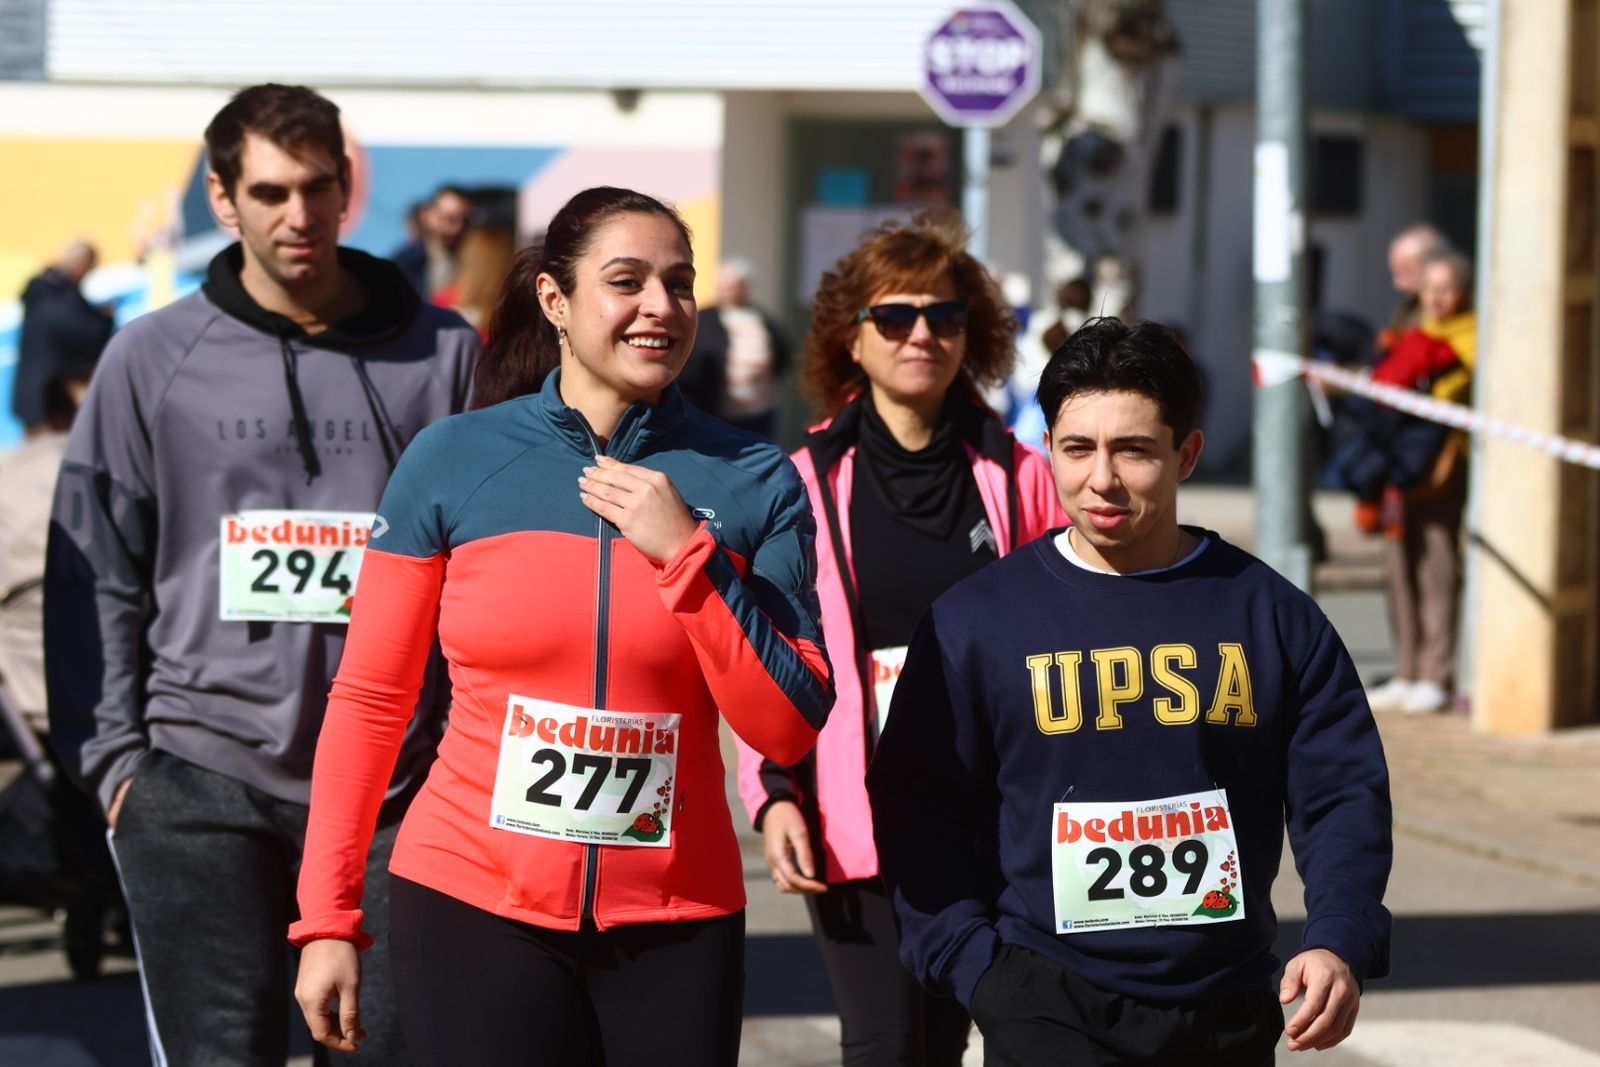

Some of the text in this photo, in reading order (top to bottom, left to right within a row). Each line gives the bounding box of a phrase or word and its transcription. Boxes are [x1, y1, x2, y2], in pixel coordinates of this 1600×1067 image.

[929, 37, 1029, 75] STOP
[217, 418, 404, 442] LOS AGEL
[227, 519, 371, 547] bedunia
[251, 549, 352, 595] 294
[1026, 643, 1258, 735] UPSA
[508, 704, 675, 755] bedunia
[525, 748, 652, 814] 277
[1057, 802, 1230, 844] bedunia
[1085, 839, 1209, 901] 289
